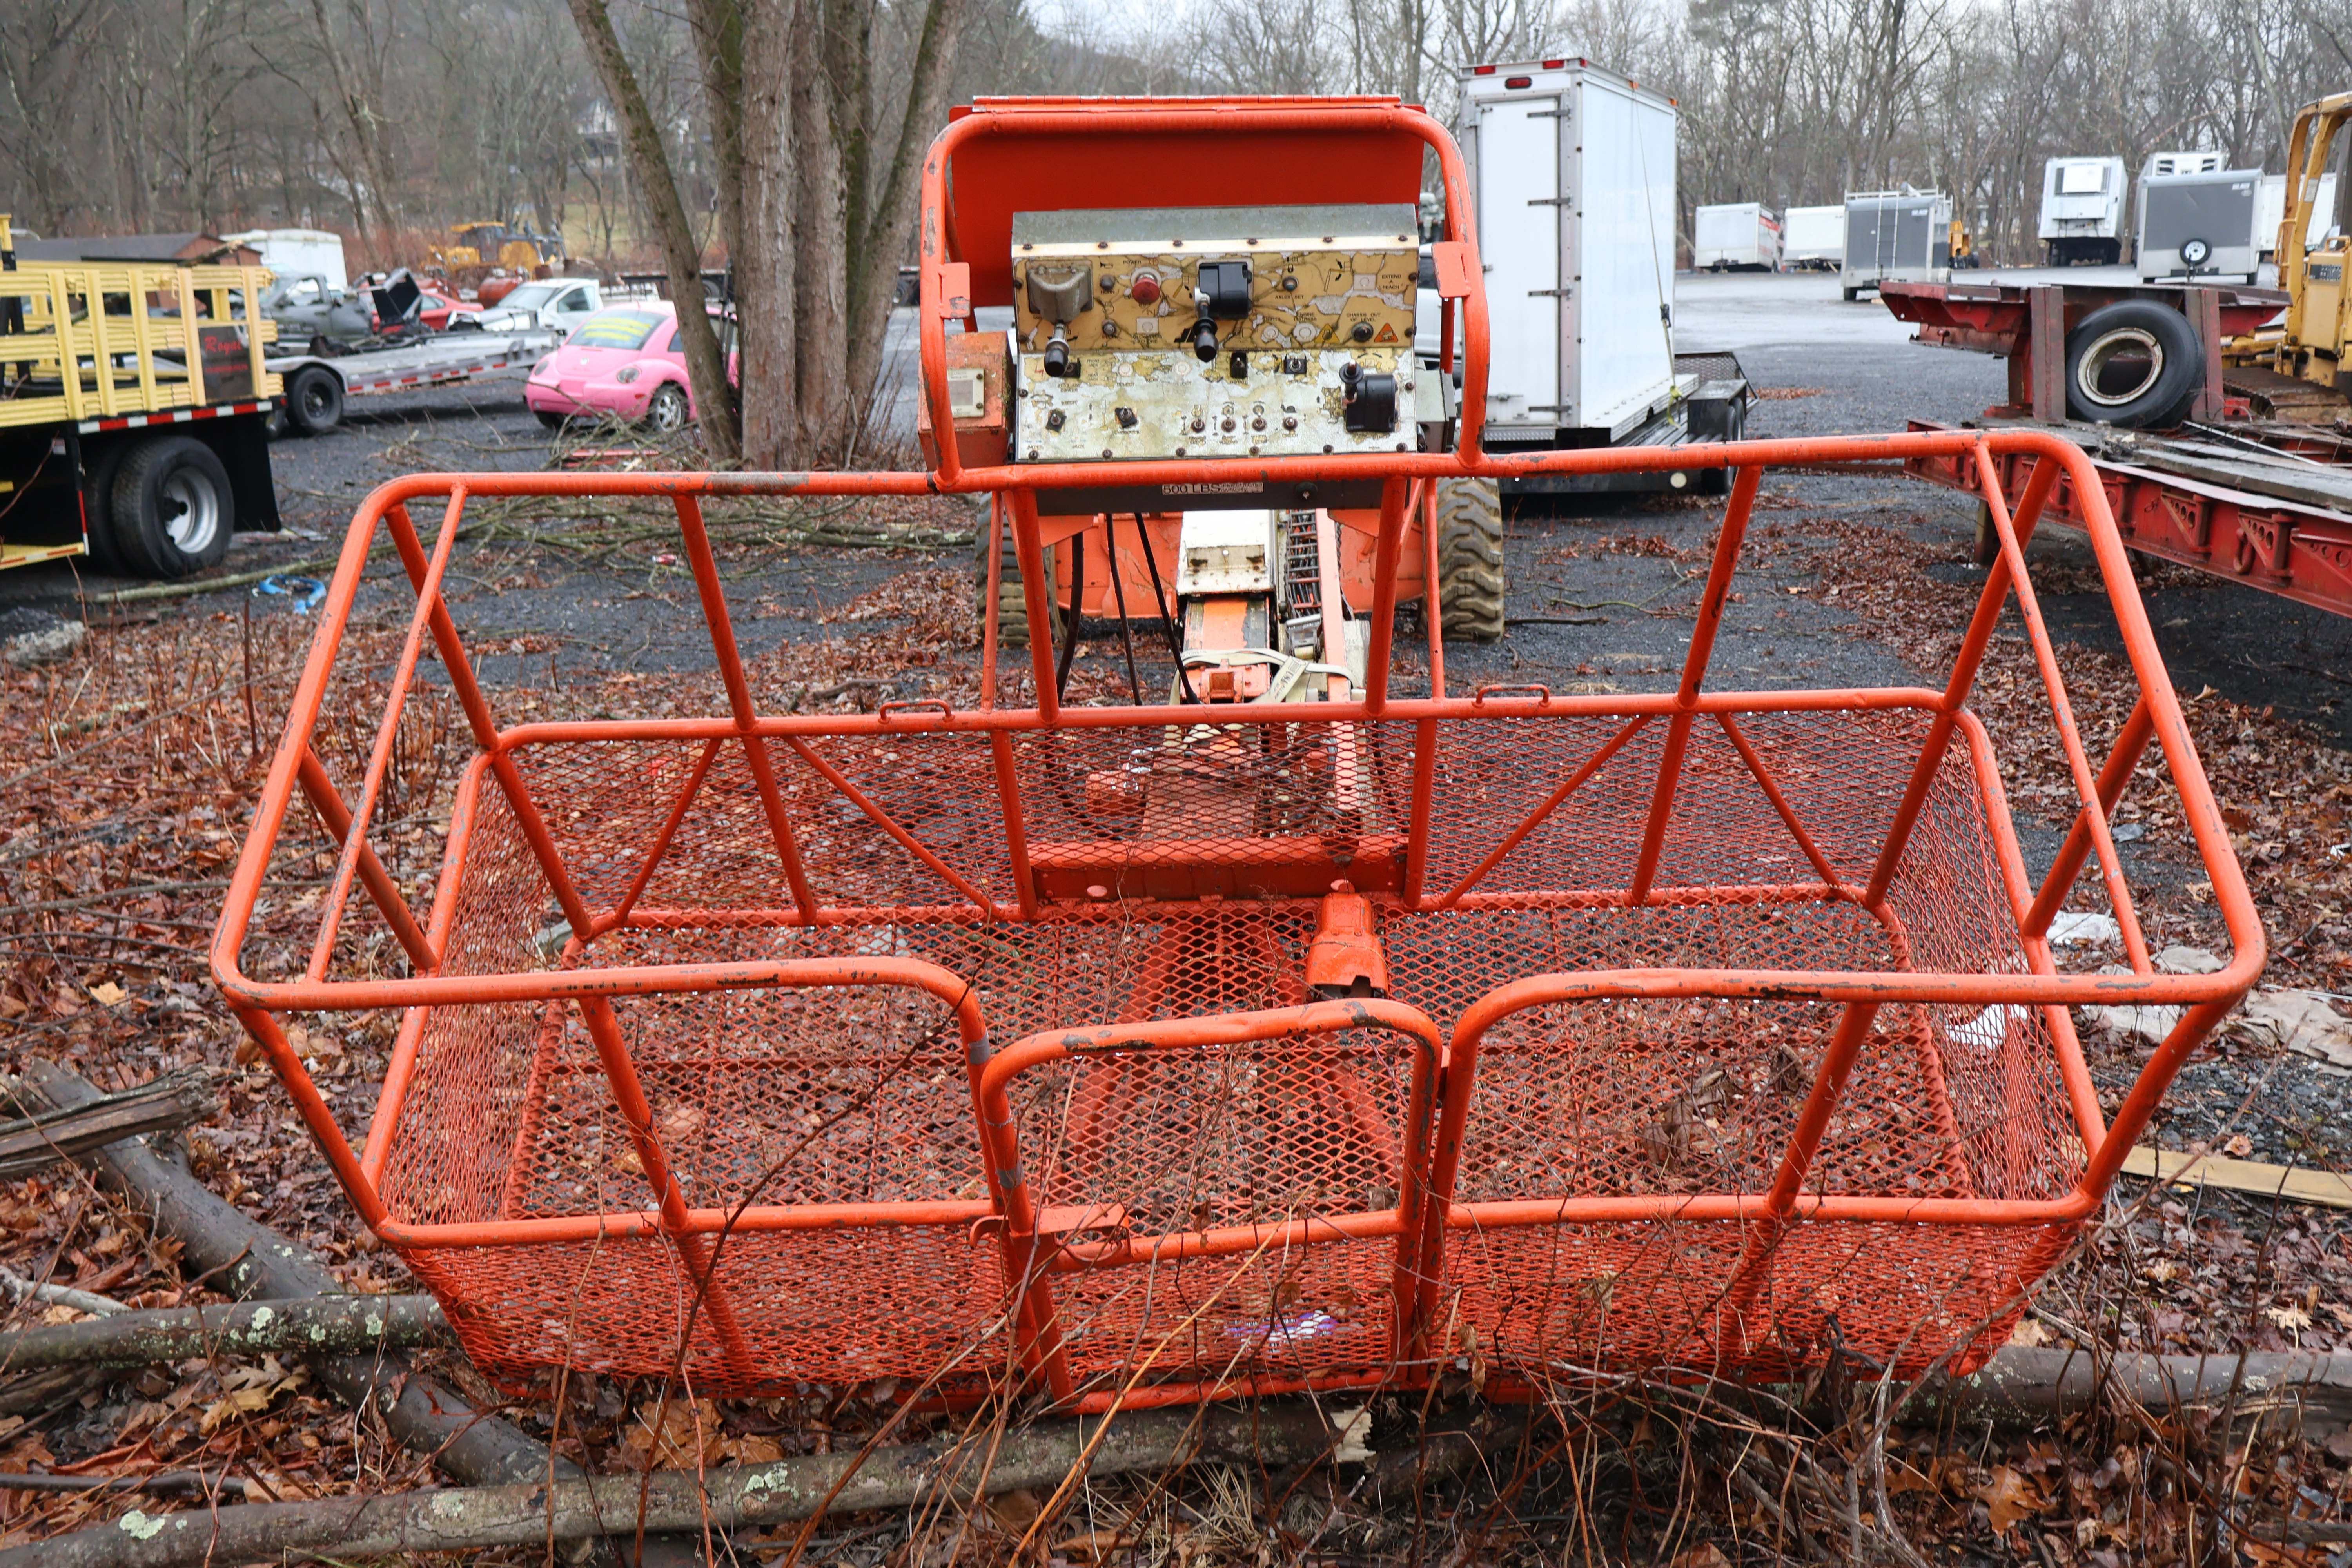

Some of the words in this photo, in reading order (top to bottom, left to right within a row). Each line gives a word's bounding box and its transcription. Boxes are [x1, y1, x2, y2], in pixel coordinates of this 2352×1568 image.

[204, 336, 242, 356] Royal
[1163, 484, 1188, 494] 500
[1192, 483, 1220, 493] LBS
